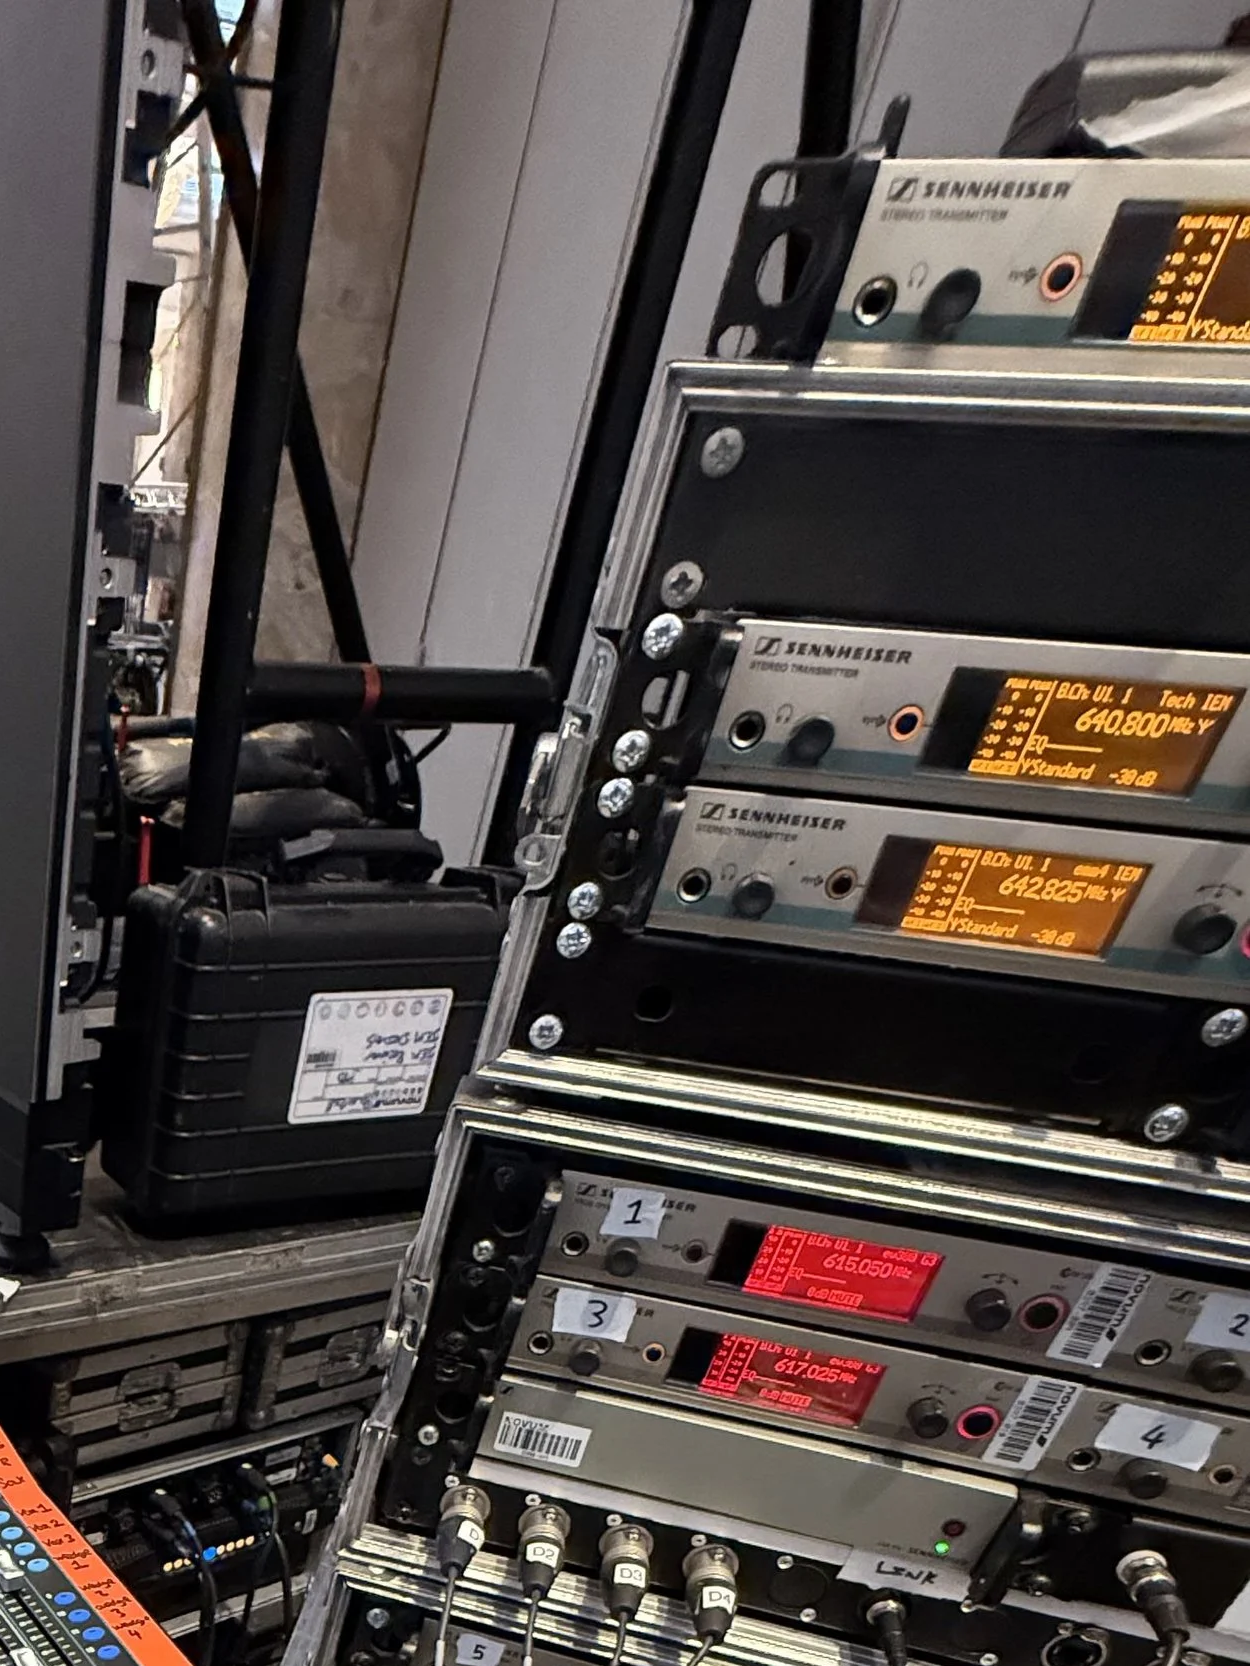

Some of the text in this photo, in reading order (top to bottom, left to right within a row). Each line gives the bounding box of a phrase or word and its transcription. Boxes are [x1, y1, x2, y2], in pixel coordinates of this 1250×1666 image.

[922, 180, 1072, 200] SENNHEISER
[784, 641, 912, 665] SENNHEISER
[1159, 690, 1194, 710] Tech
[1201, 693, 1234, 712] IEM
[1075, 708, 1169, 738] 640.800
[1030, 759, 1096, 780] Standard
[727, 807, 846, 832] SENNHEISER
[1113, 865, 1144, 882] IEM
[959, 918, 1018, 939] Standard
[623, 1200, 642, 1225] 1
[823, 1253, 892, 1278] 615.050
[1114, 1273, 1151, 1327] novum
[587, 1299, 608, 1328] 3
[1228, 1313, 1250, 1337] 2
[774, 1358, 839, 1383] 617.025
[1044, 1385, 1078, 1436] novum
[1140, 1424, 1166, 1450] 4
[48, 1519, 65, 1529] 2
[63, 1533, 76, 1544] 3
[533, 1546, 555, 1560] D2
[71, 1560, 90, 1570] 1
[620, 1568, 643, 1582] D3
[876, 1560, 938, 1585] LINK
[110, 1607, 127, 1618] 3
[128, 1628, 143, 1640] 4
[472, 1644, 487, 1660] 5
